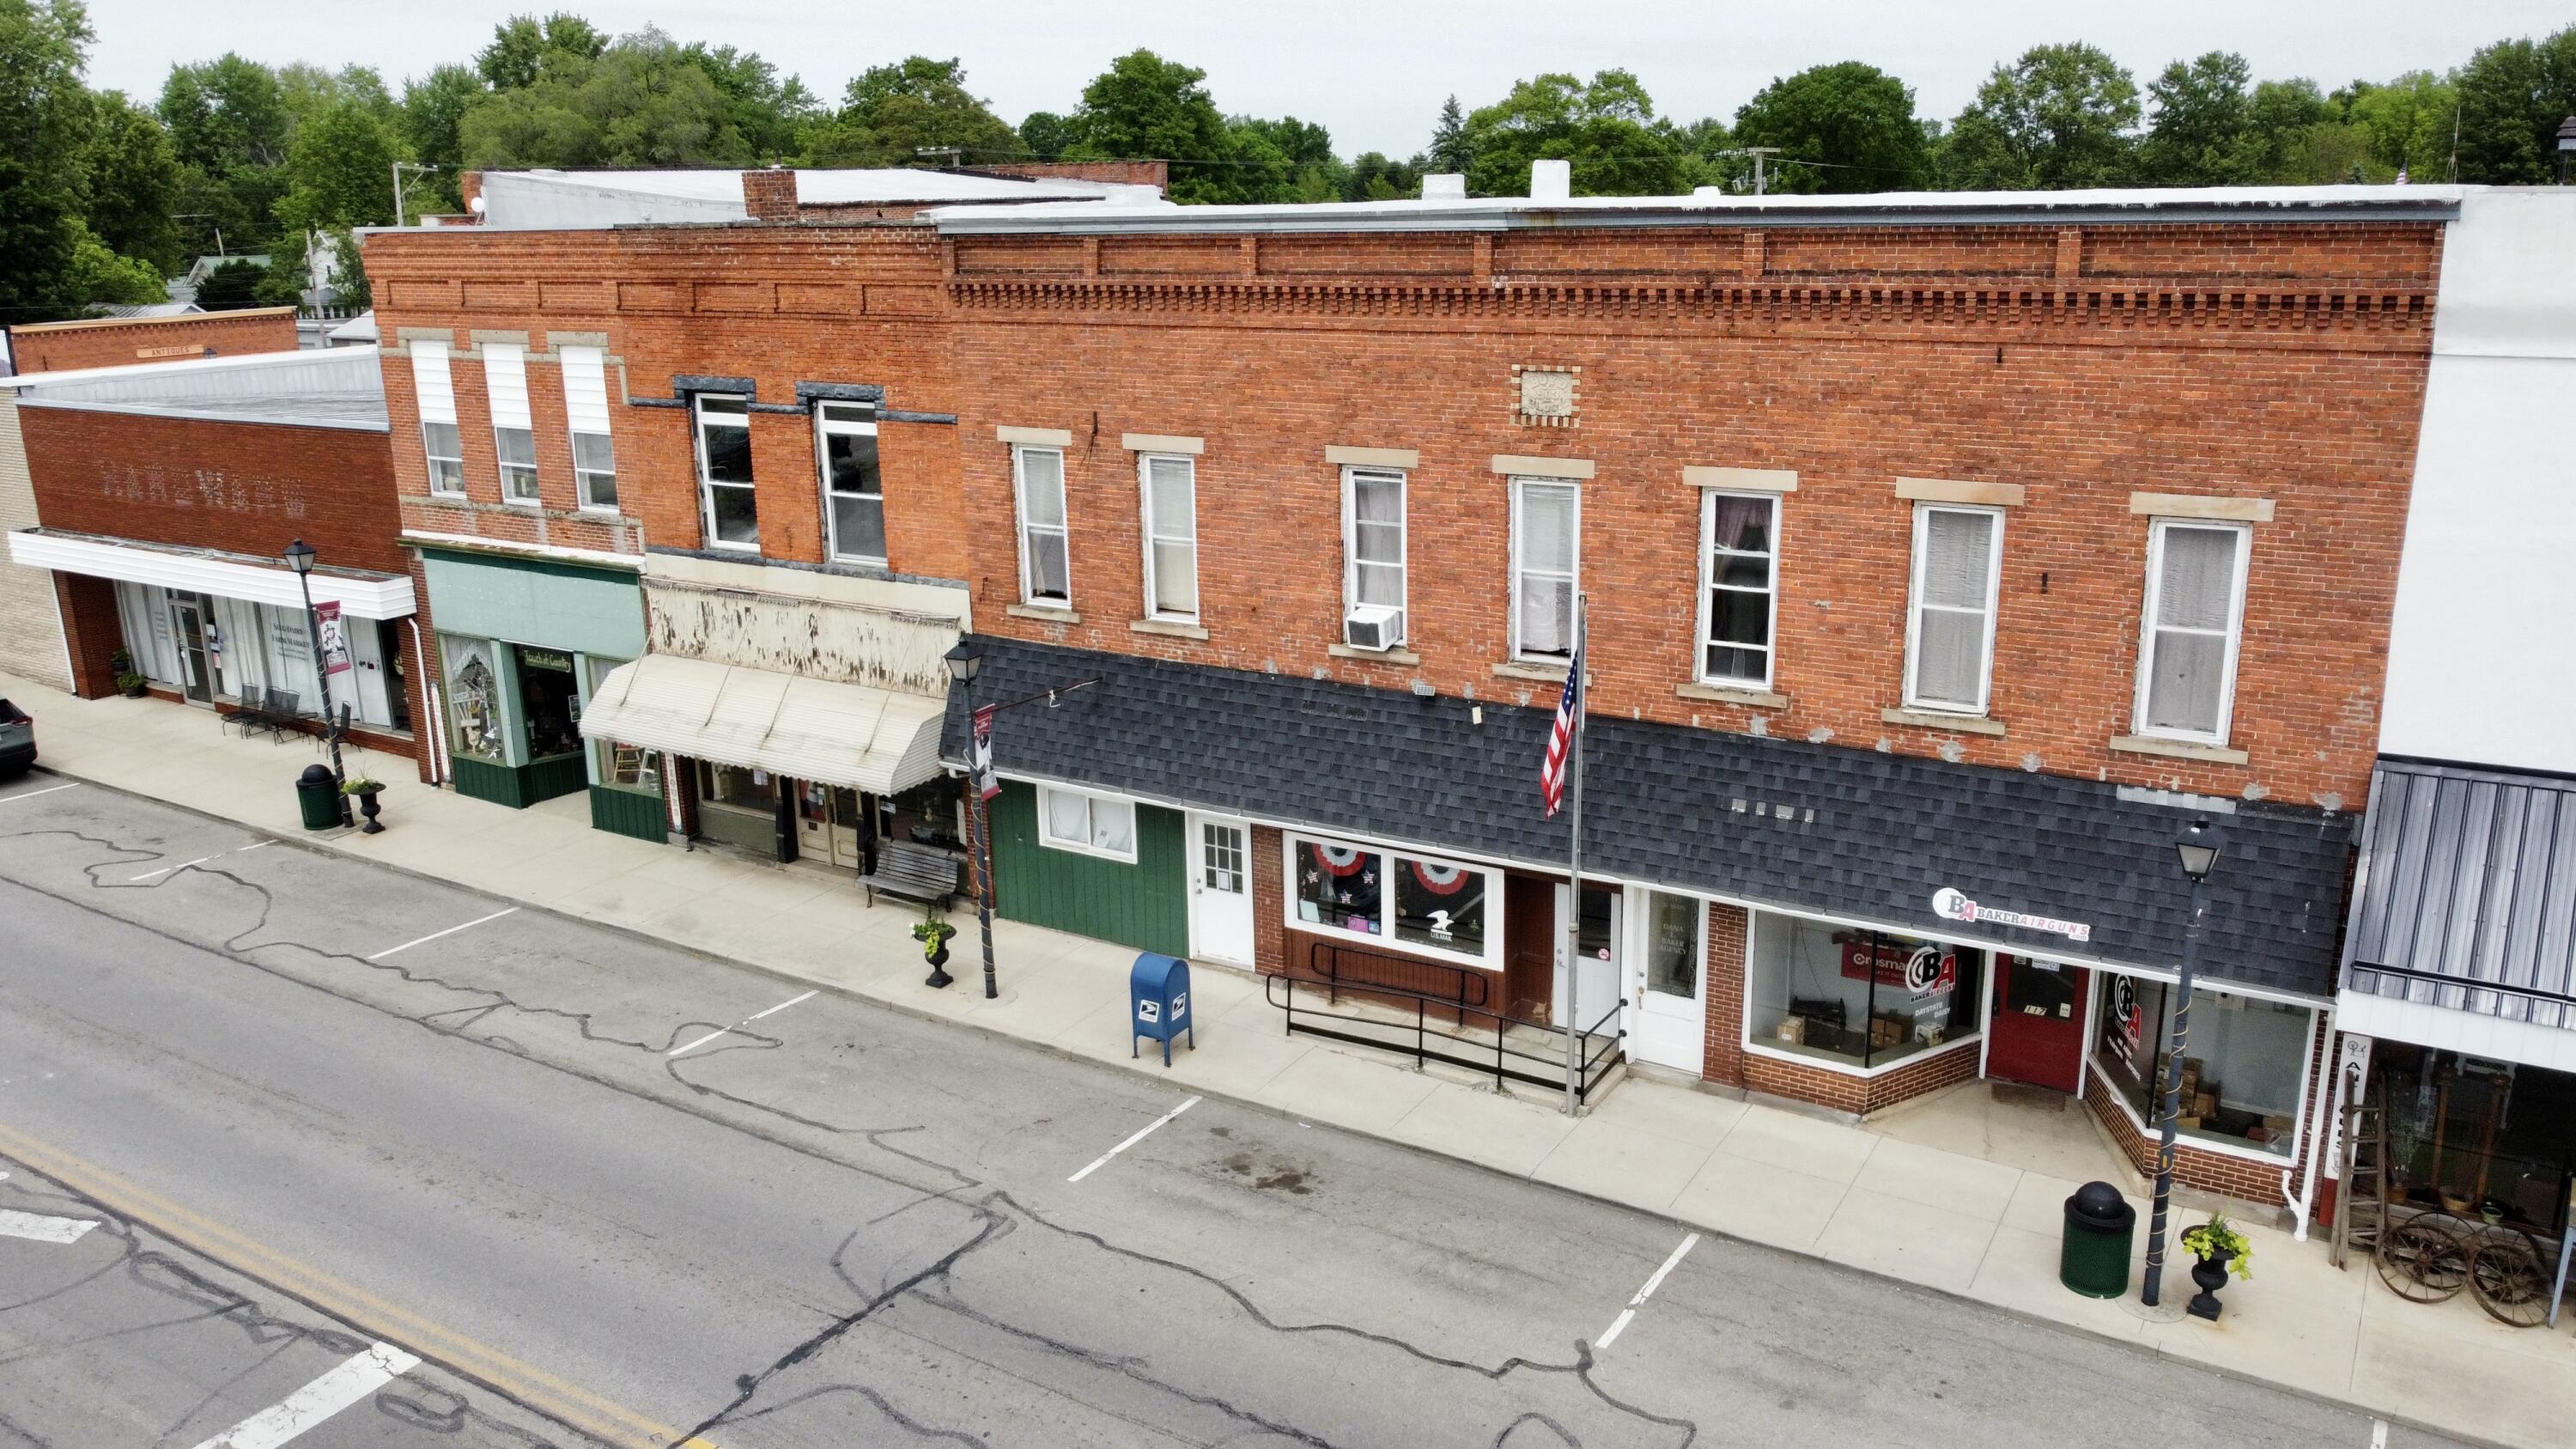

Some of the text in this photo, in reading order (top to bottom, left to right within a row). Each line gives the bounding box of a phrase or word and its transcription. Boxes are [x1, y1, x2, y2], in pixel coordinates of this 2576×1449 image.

[151, 346, 190, 356] ANTIQUES
[524, 649, 543, 664] Touch
[550, 654, 571, 673] Country
[1663, 922, 1684, 932] DANA
[1662, 937, 1685, 947] BAKER
[1853, 953, 1906, 971] Crsma
[1915, 1002, 1943, 1017] DAYSTATE
[1934, 1007, 1951, 1019] DAISY
